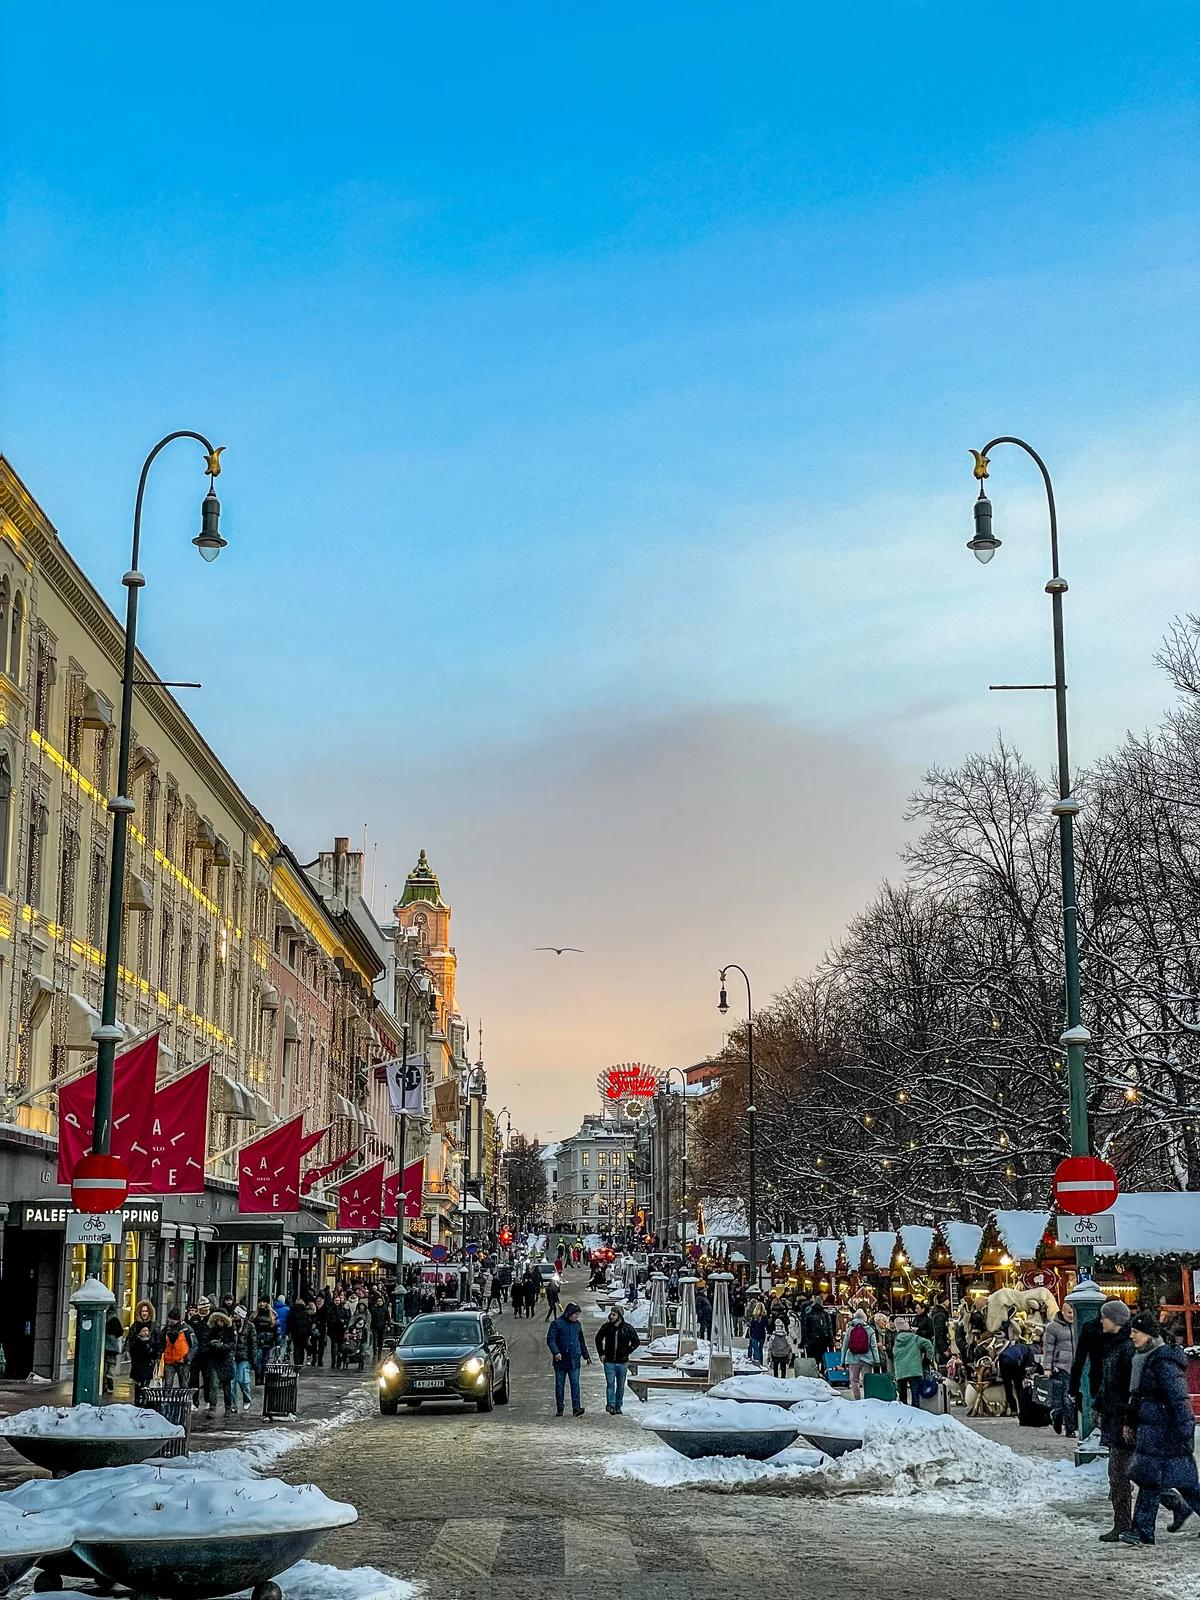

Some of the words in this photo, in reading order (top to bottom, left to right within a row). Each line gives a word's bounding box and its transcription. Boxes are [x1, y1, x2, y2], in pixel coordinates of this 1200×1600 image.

[607, 1067, 656, 1098] Freia
[437, 1104, 455, 1113] HOTEL
[79, 1233, 103, 1242] unnta
[318, 1236, 353, 1244] SHOPPING
[1071, 1235, 1103, 1243] unntatt
